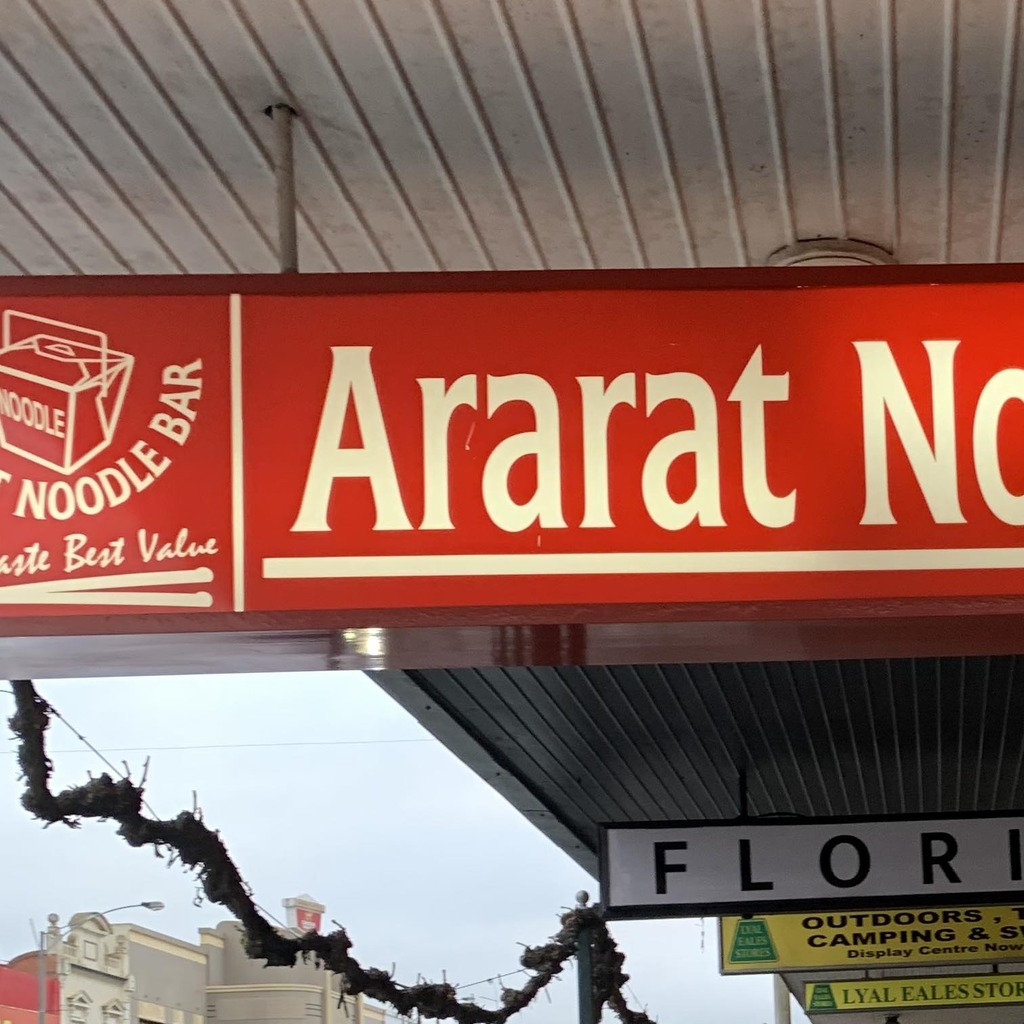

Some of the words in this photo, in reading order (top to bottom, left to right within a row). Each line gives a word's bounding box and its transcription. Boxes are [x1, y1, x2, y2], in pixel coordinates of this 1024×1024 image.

[0, 387, 66, 440] NOODLE
[12, 440, 172, 521] NOODLE
[148, 357, 204, 447] BAR
[290, 343, 798, 534] Ararat
[63, 532, 126, 574] Best
[137, 527, 220, 563] Value
[802, 909, 983, 930] OUTDOORS
[807, 928, 957, 948] CAMPING
[967, 926, 991, 941] &
[847, 948, 912, 960] Display
[918, 944, 978, 956] Centre
[985, 942, 1024, 952] Now
[842, 987, 898, 1005] LYAL
[901, 984, 970, 1002] EALES
